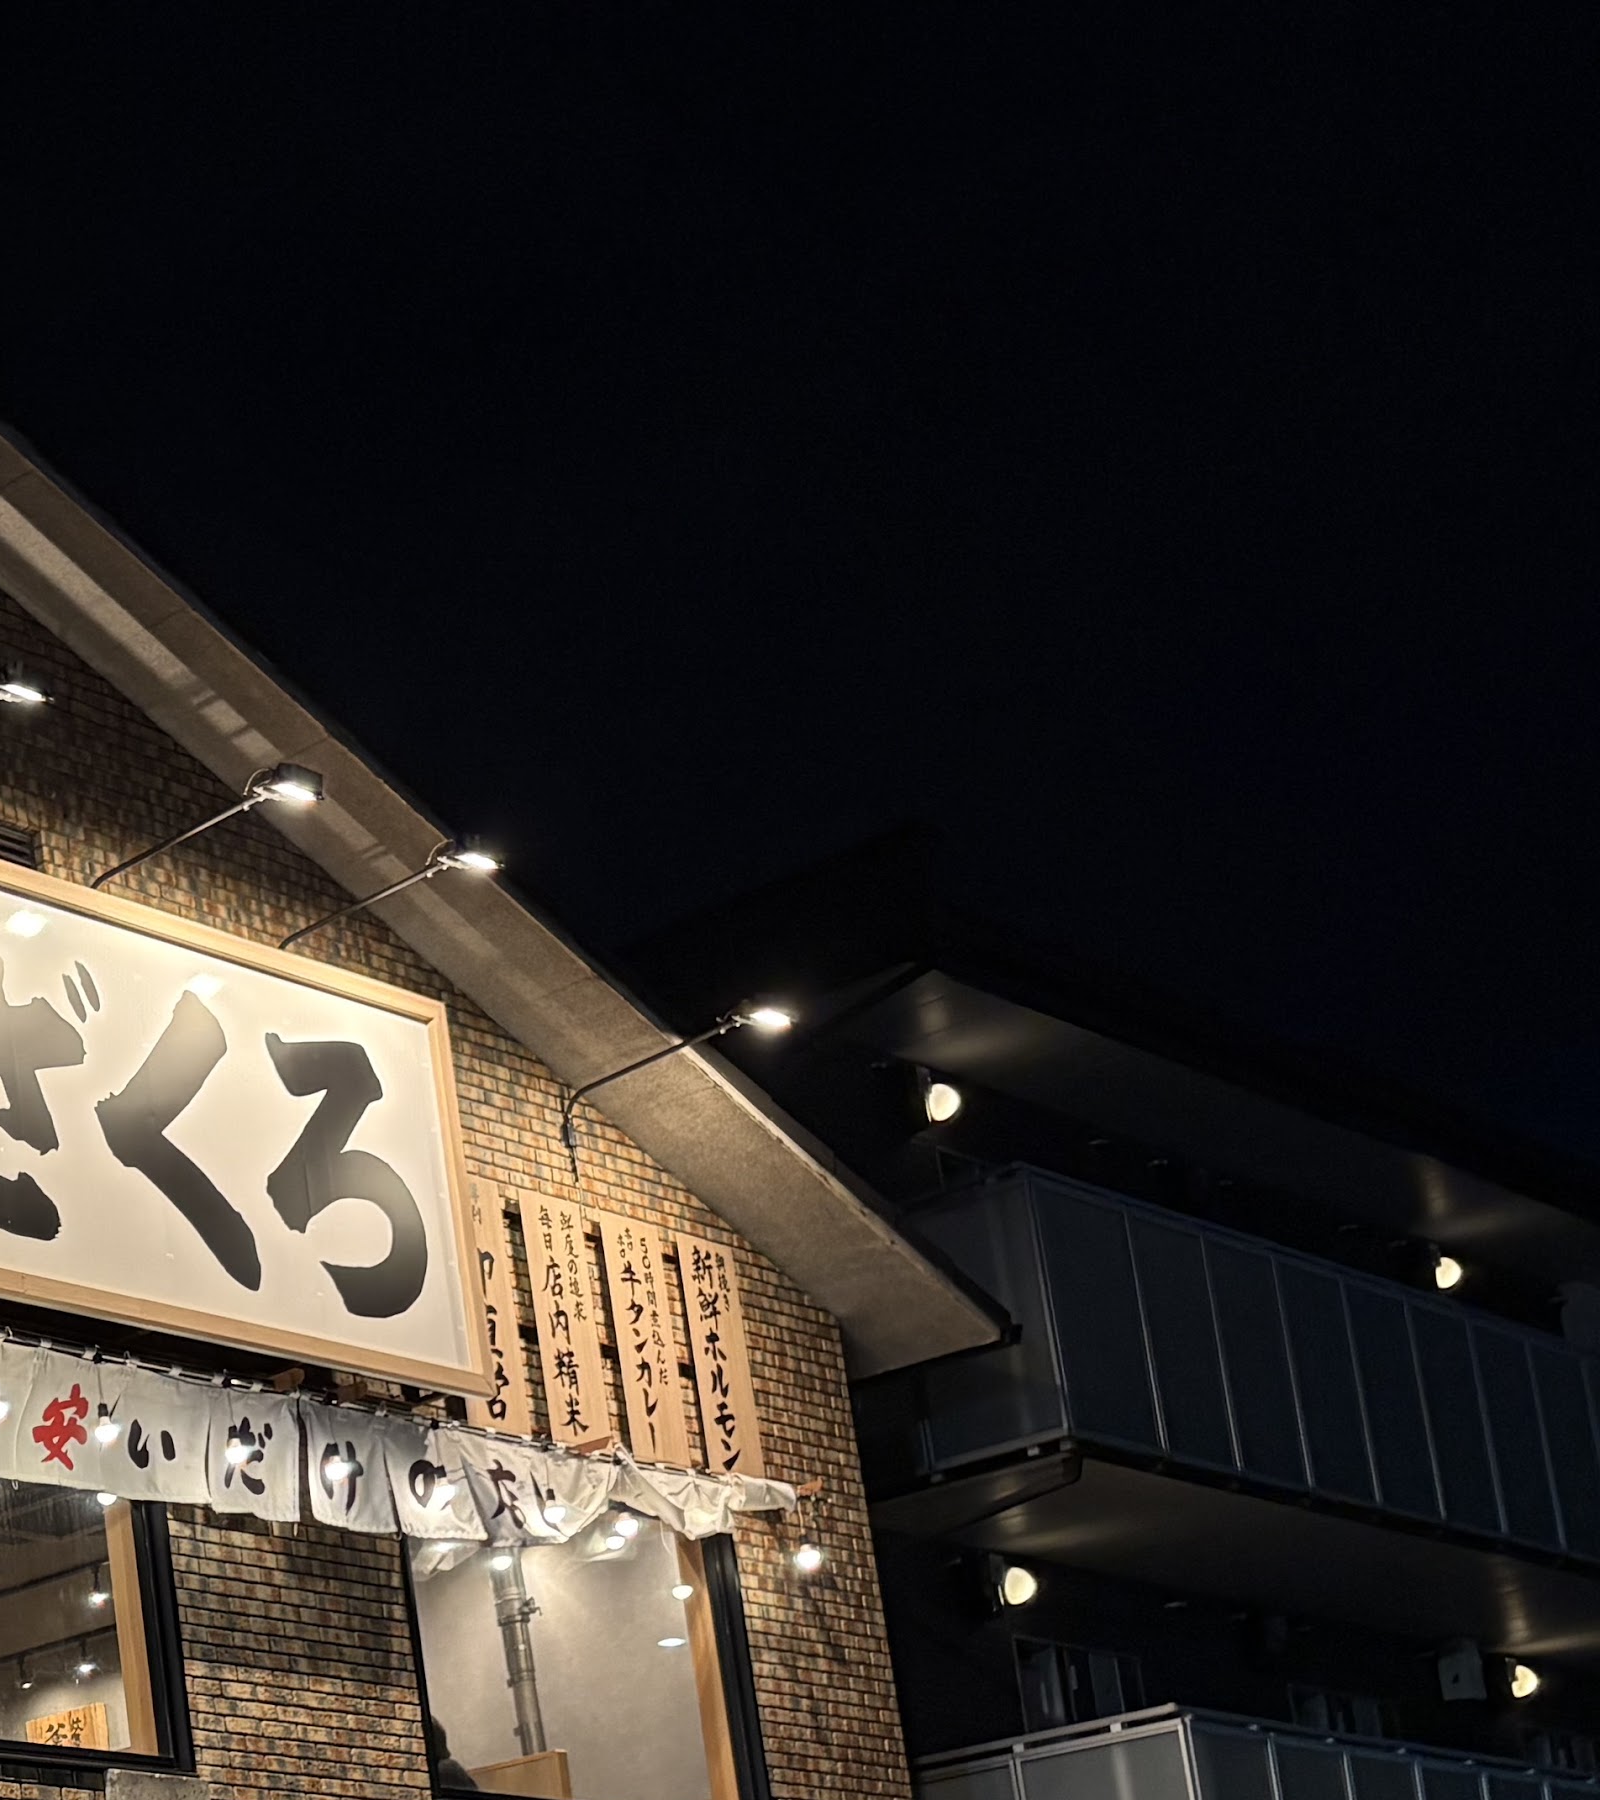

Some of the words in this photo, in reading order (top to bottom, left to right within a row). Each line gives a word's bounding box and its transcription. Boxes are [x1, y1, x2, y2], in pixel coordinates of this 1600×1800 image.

[690, 1245, 741, 1472] 新鮮ホルモン
